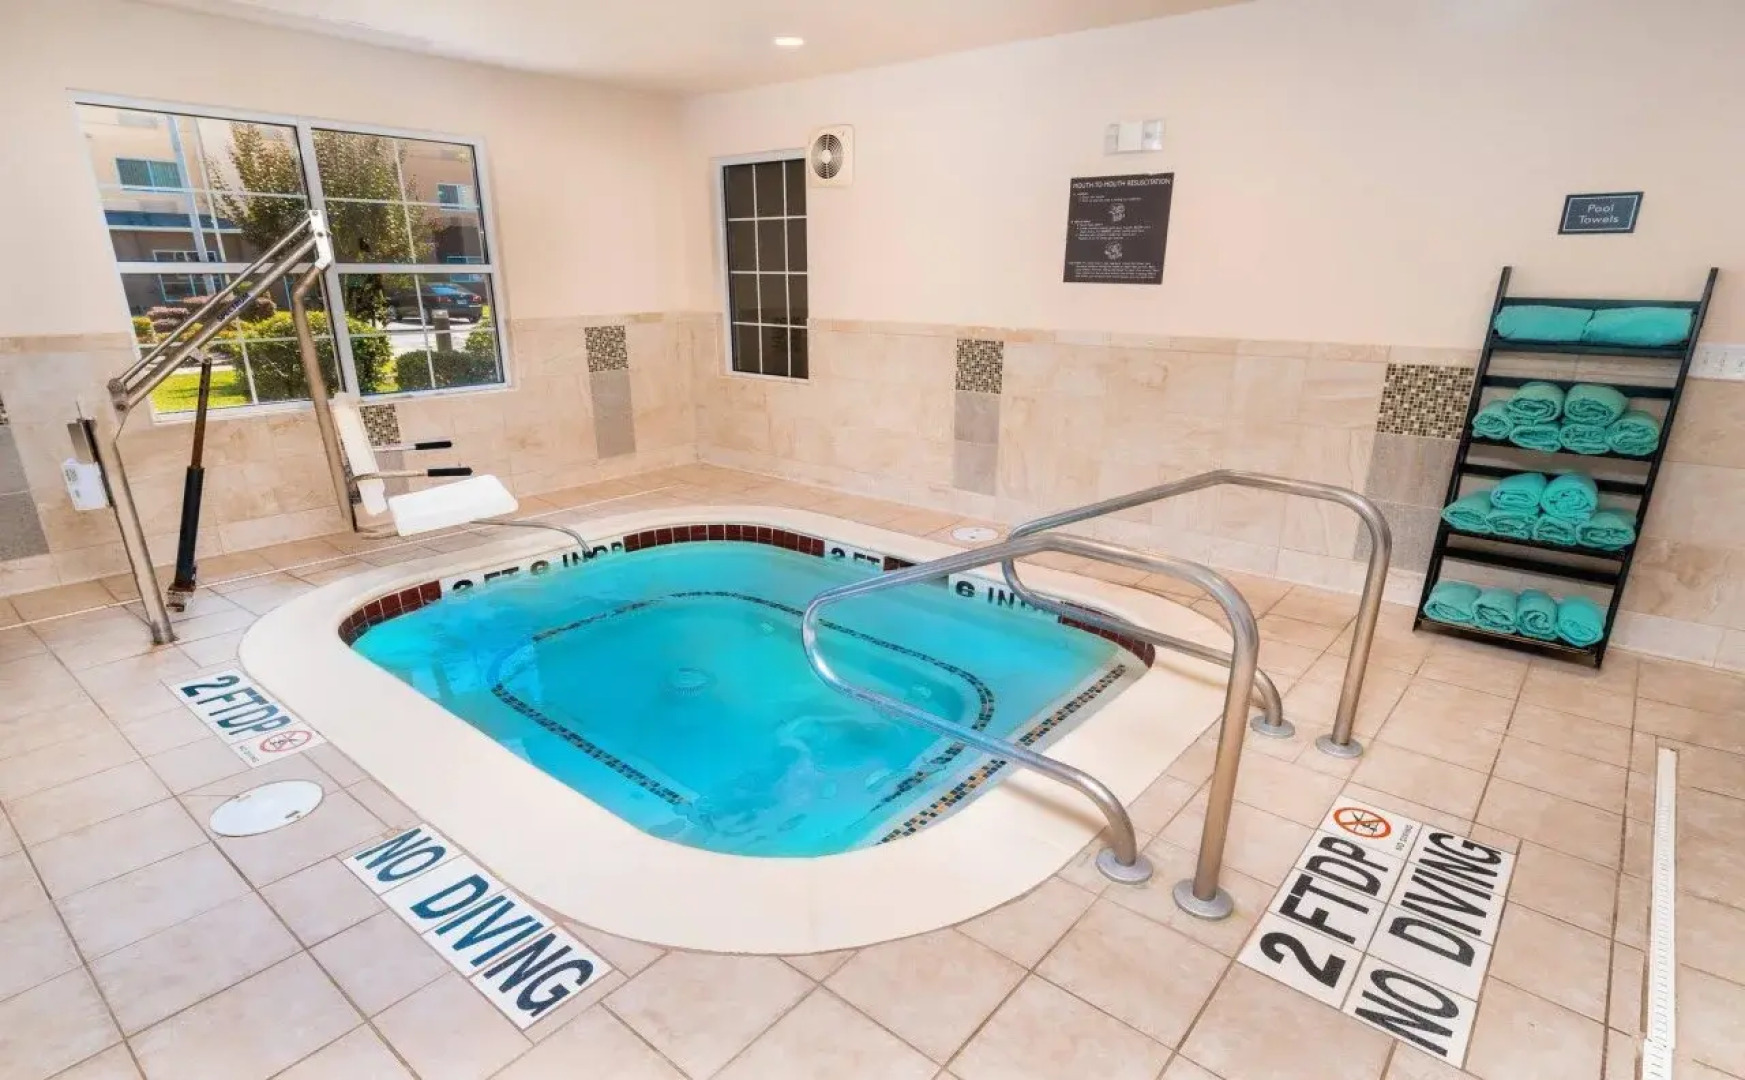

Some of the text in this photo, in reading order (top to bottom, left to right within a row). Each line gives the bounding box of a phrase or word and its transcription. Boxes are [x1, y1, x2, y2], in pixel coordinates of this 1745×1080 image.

[1579, 215, 1620, 224] Towels
[1587, 204, 1615, 213] Pool
[354, 828, 594, 1028] NO DIVING
[1354, 831, 1502, 1058] NO DIVING
[1259, 931, 1347, 989] 2
